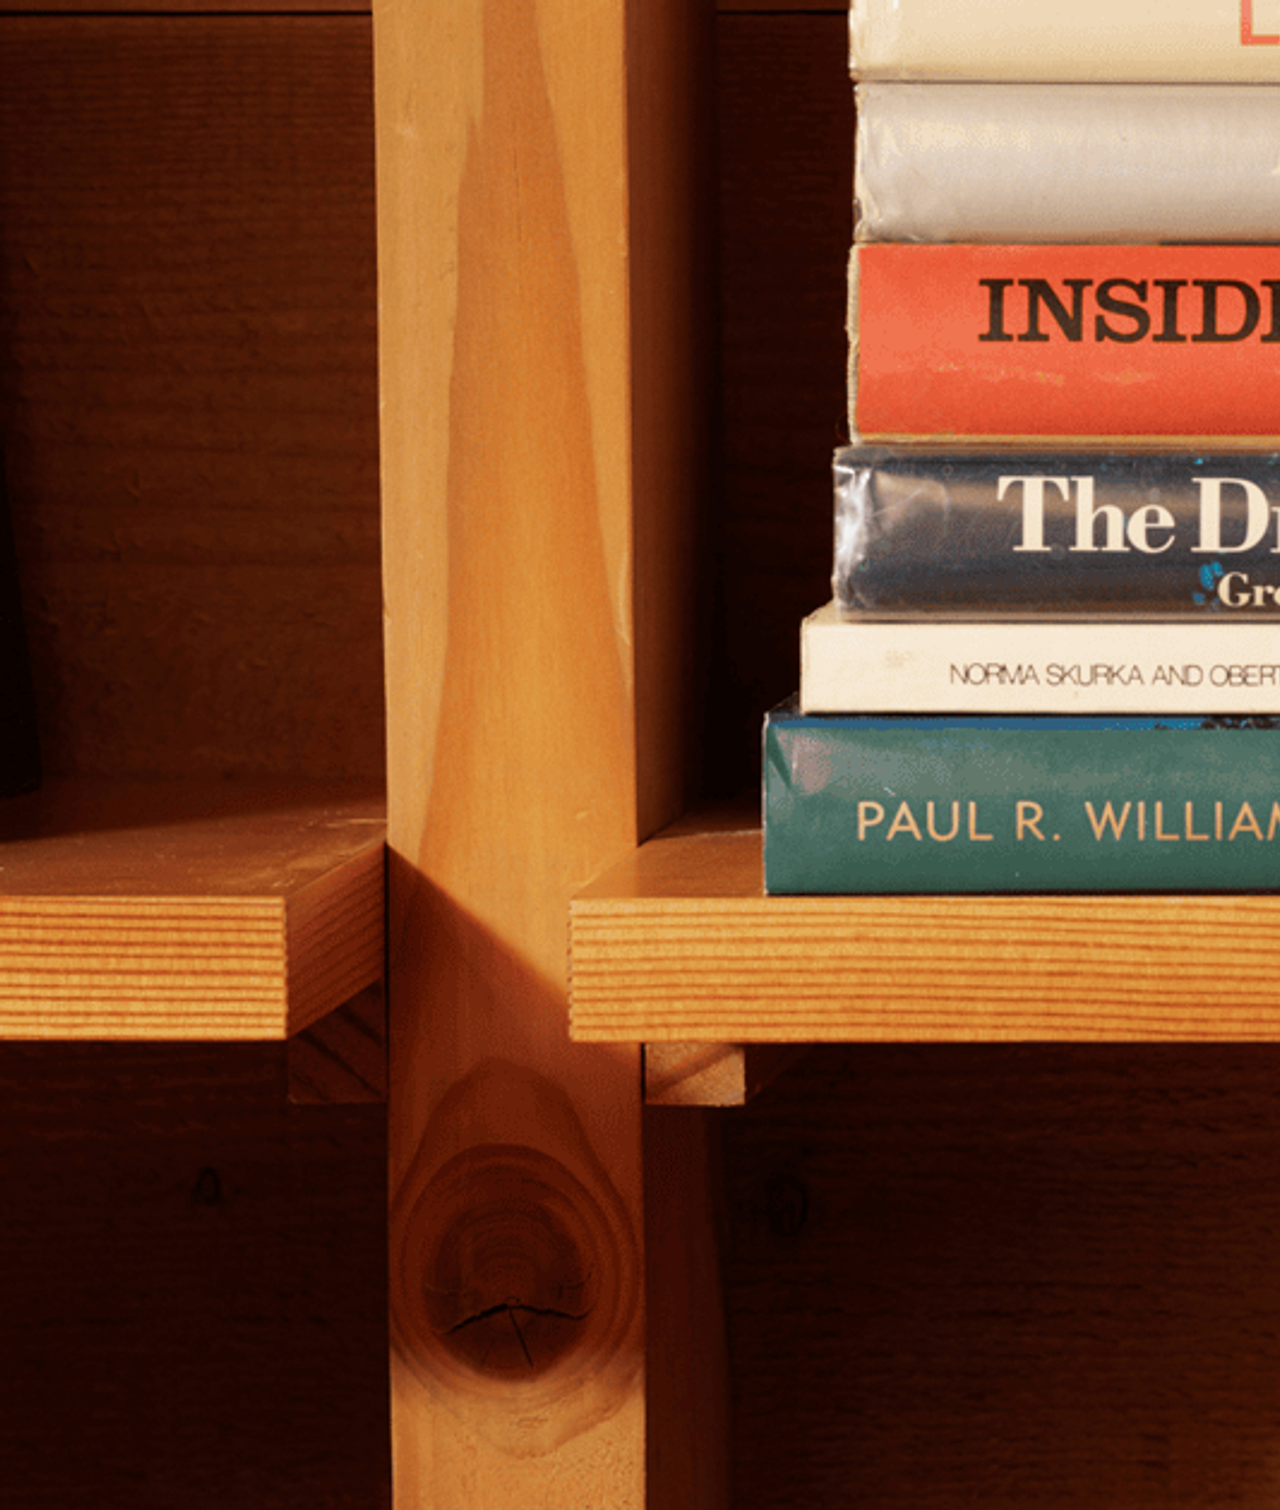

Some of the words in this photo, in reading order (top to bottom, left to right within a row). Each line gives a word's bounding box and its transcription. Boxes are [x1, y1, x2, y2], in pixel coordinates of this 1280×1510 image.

[997, 475, 1175, 554] The
[949, 663, 1039, 687] NORMA
[1045, 663, 1144, 687] SKURKA
[1151, 663, 1203, 687] AND
[857, 801, 993, 843] PAUL
[1016, 801, 1062, 843] R.
